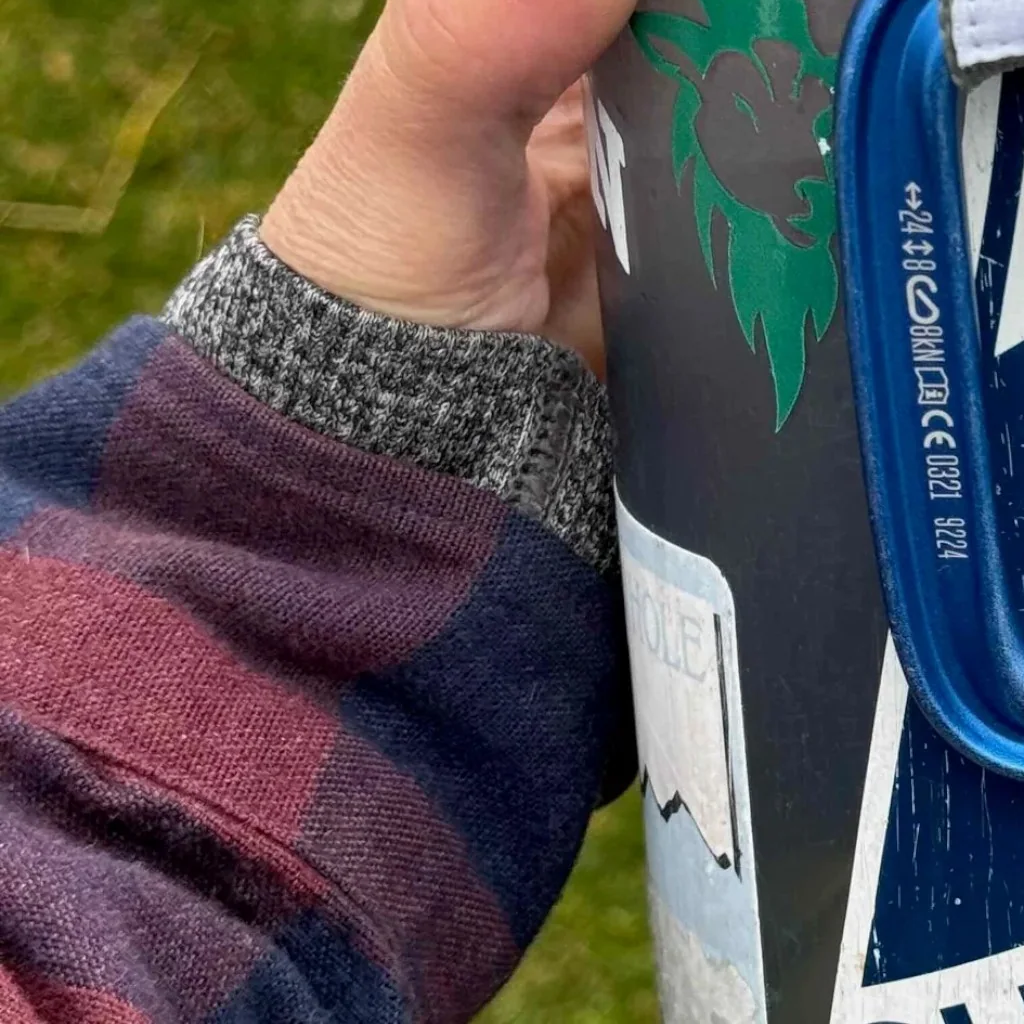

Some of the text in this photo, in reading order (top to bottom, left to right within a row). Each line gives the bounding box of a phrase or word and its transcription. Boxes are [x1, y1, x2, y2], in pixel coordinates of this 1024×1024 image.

[898, 210, 934, 233] 24
[902, 259, 937, 270] 8
[908, 325, 945, 362] 8kN
[926, 454, 963, 500] 0321
[934, 517, 969, 559] 9224
